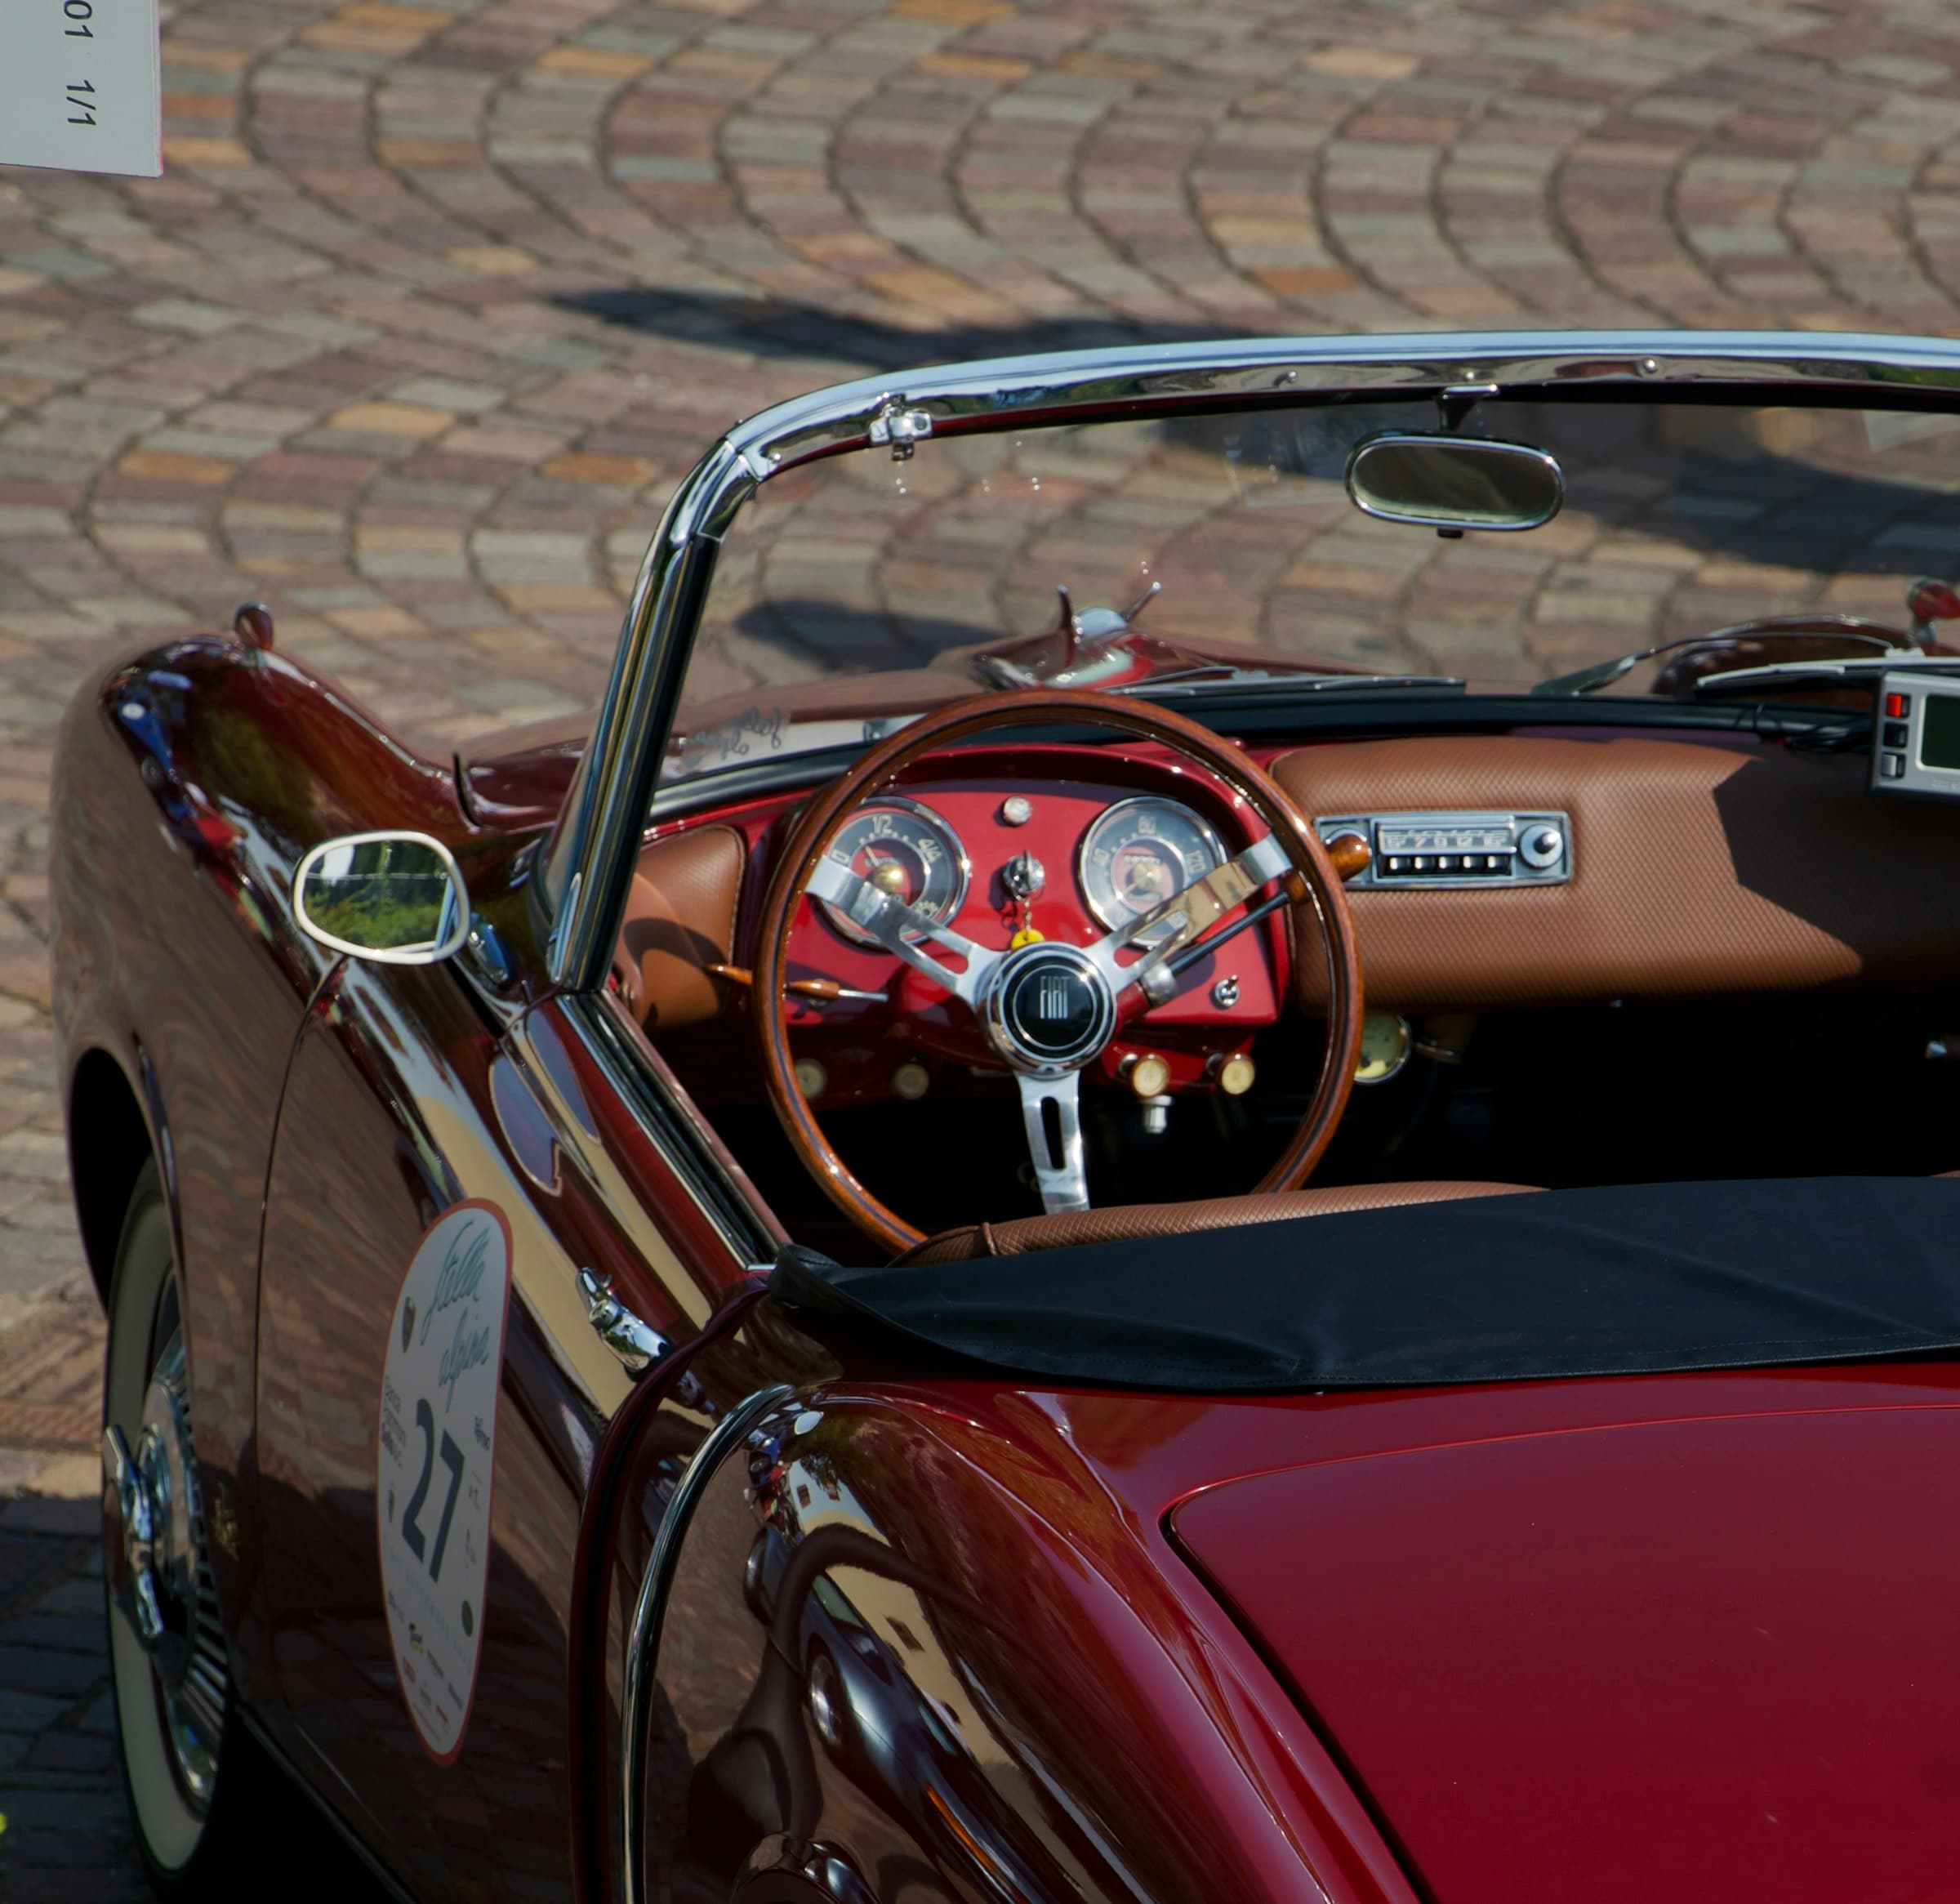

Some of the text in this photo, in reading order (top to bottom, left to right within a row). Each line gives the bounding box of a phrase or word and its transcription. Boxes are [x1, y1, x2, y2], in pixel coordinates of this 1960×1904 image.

[66, 79, 96, 126] 1/1
[1040, 975, 1071, 1019] FIAT
[402, 1398, 465, 1585] 27
